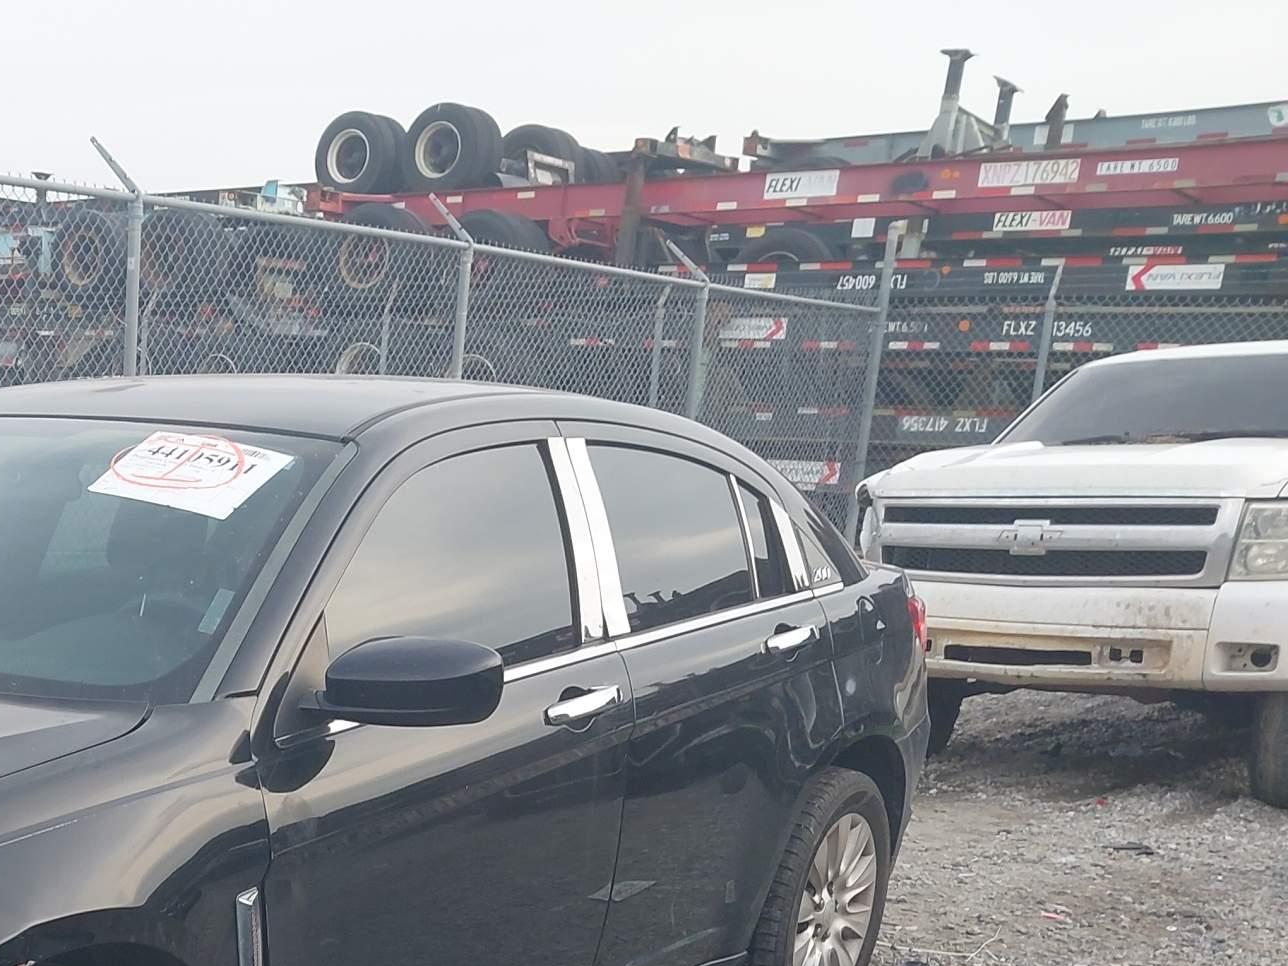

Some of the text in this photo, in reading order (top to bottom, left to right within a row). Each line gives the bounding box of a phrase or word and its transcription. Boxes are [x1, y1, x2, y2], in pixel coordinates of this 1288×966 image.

[766, 177, 802, 193] FLEXI
[836, 274, 908, 290] FLX 600457
[984, 272, 997, 284] LBS
[1001, 320, 1036, 336] FLXZ
[901, 416, 989, 432] FLXZ 417356
